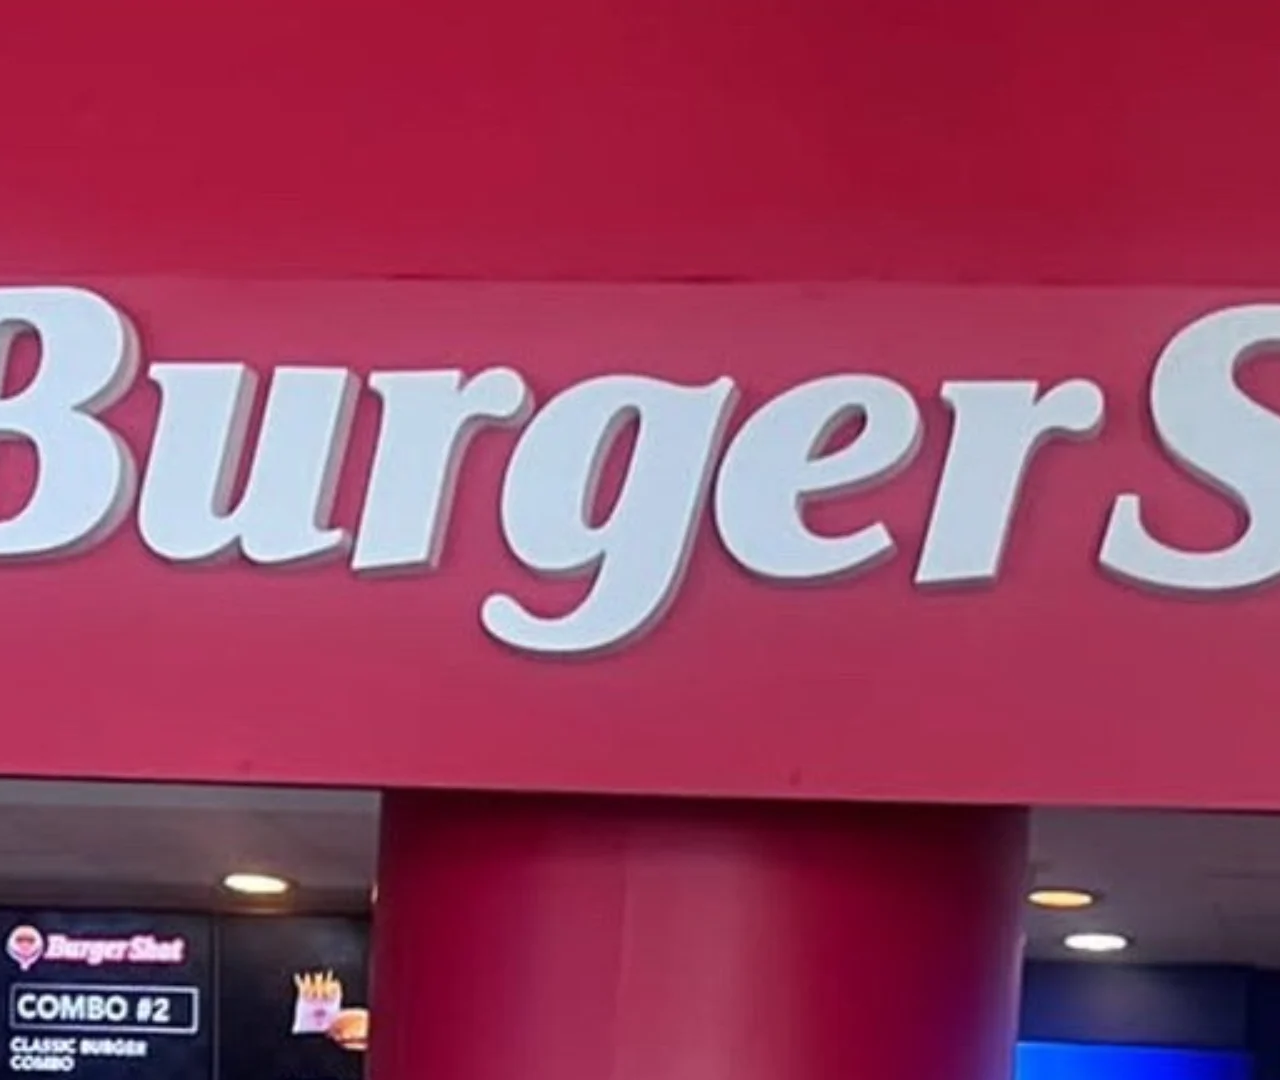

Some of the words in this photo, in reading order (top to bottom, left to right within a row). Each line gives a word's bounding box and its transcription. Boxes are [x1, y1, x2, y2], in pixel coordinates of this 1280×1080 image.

[17, 993, 128, 1021] COMBO
[136, 997, 170, 1022] #2
[9, 1036, 76, 1054] CLASSIC
[80, 1038, 147, 1056] BURGER
[9, 1054, 75, 1072] COMBO
